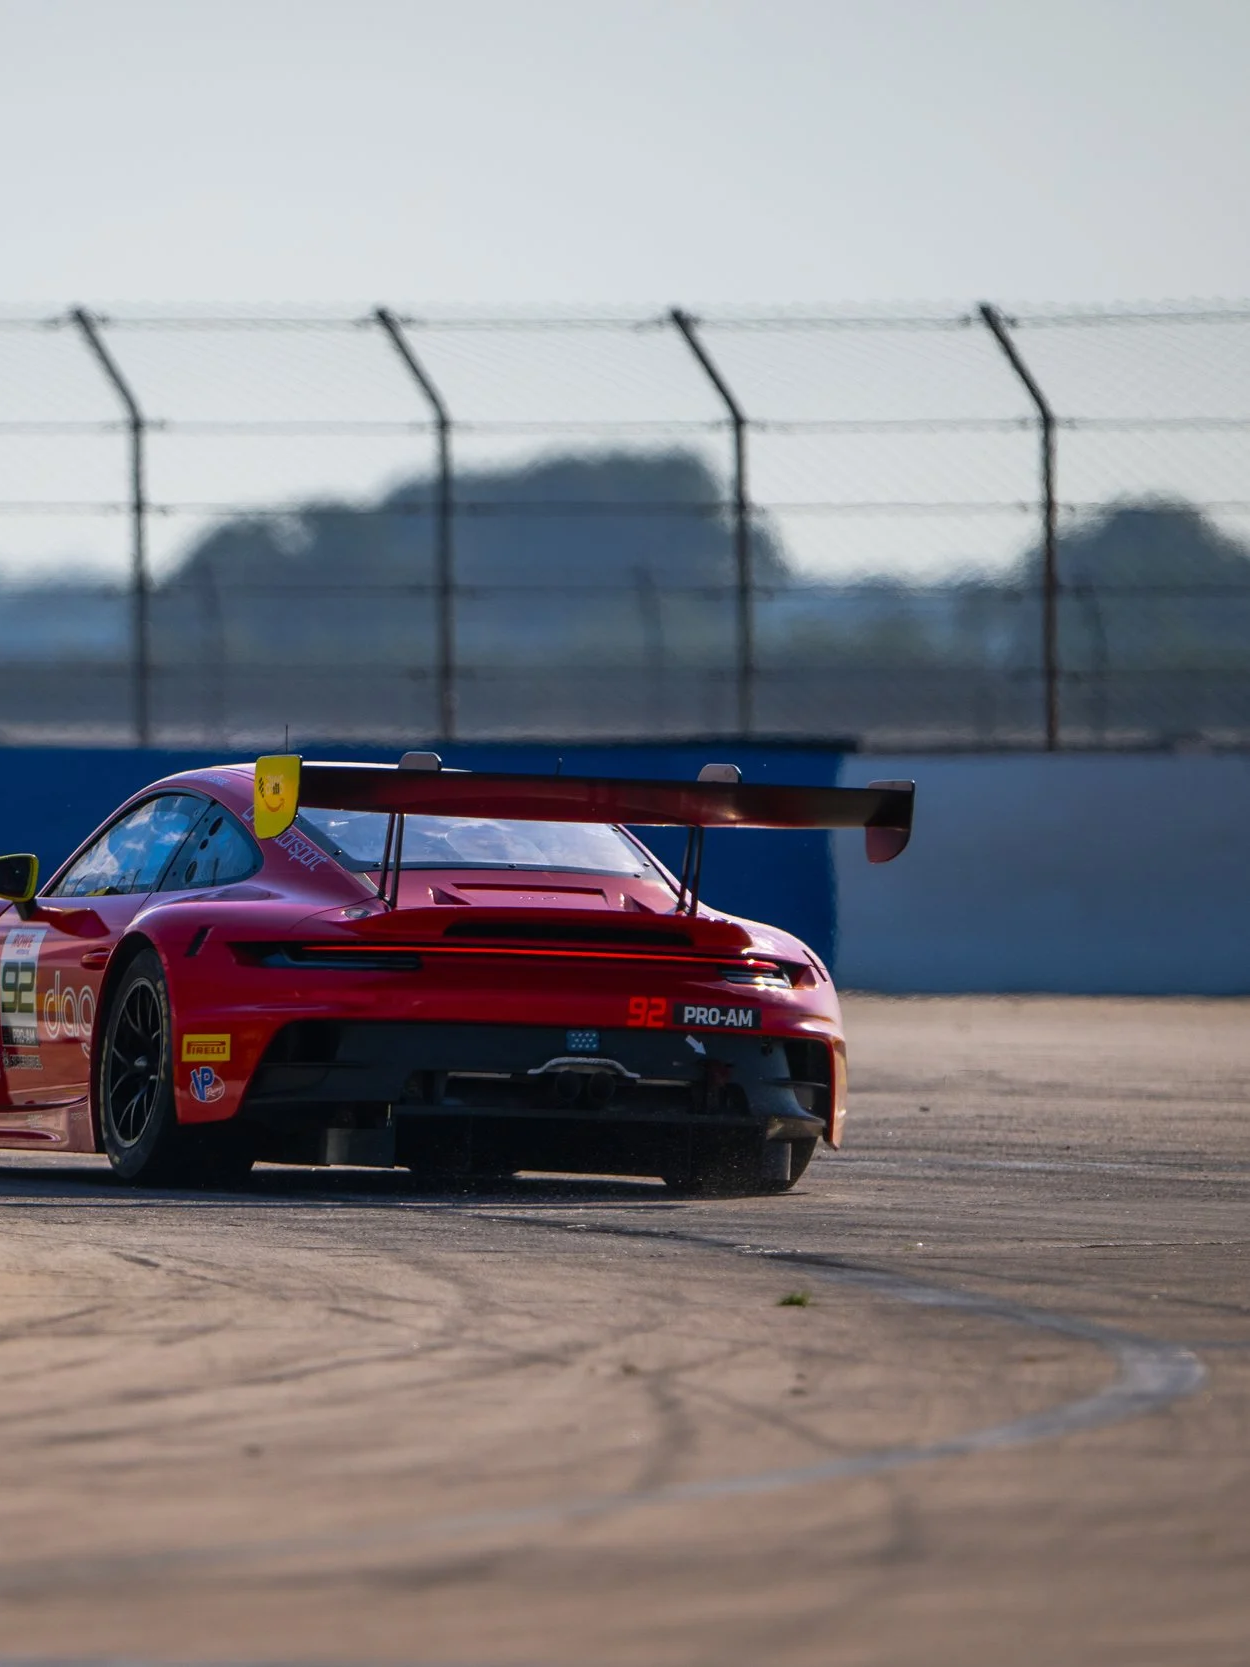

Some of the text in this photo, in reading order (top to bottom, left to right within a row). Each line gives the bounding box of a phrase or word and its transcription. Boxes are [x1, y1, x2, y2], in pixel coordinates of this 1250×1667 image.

[274, 831, 327, 871] torsport
[2, 962, 35, 1013] 92
[628, 997, 665, 1027] 92
[684, 1006, 752, 1027] PRO-AM
[187, 1041, 226, 1055] PIRELLI
[191, 1067, 214, 1100] VP
